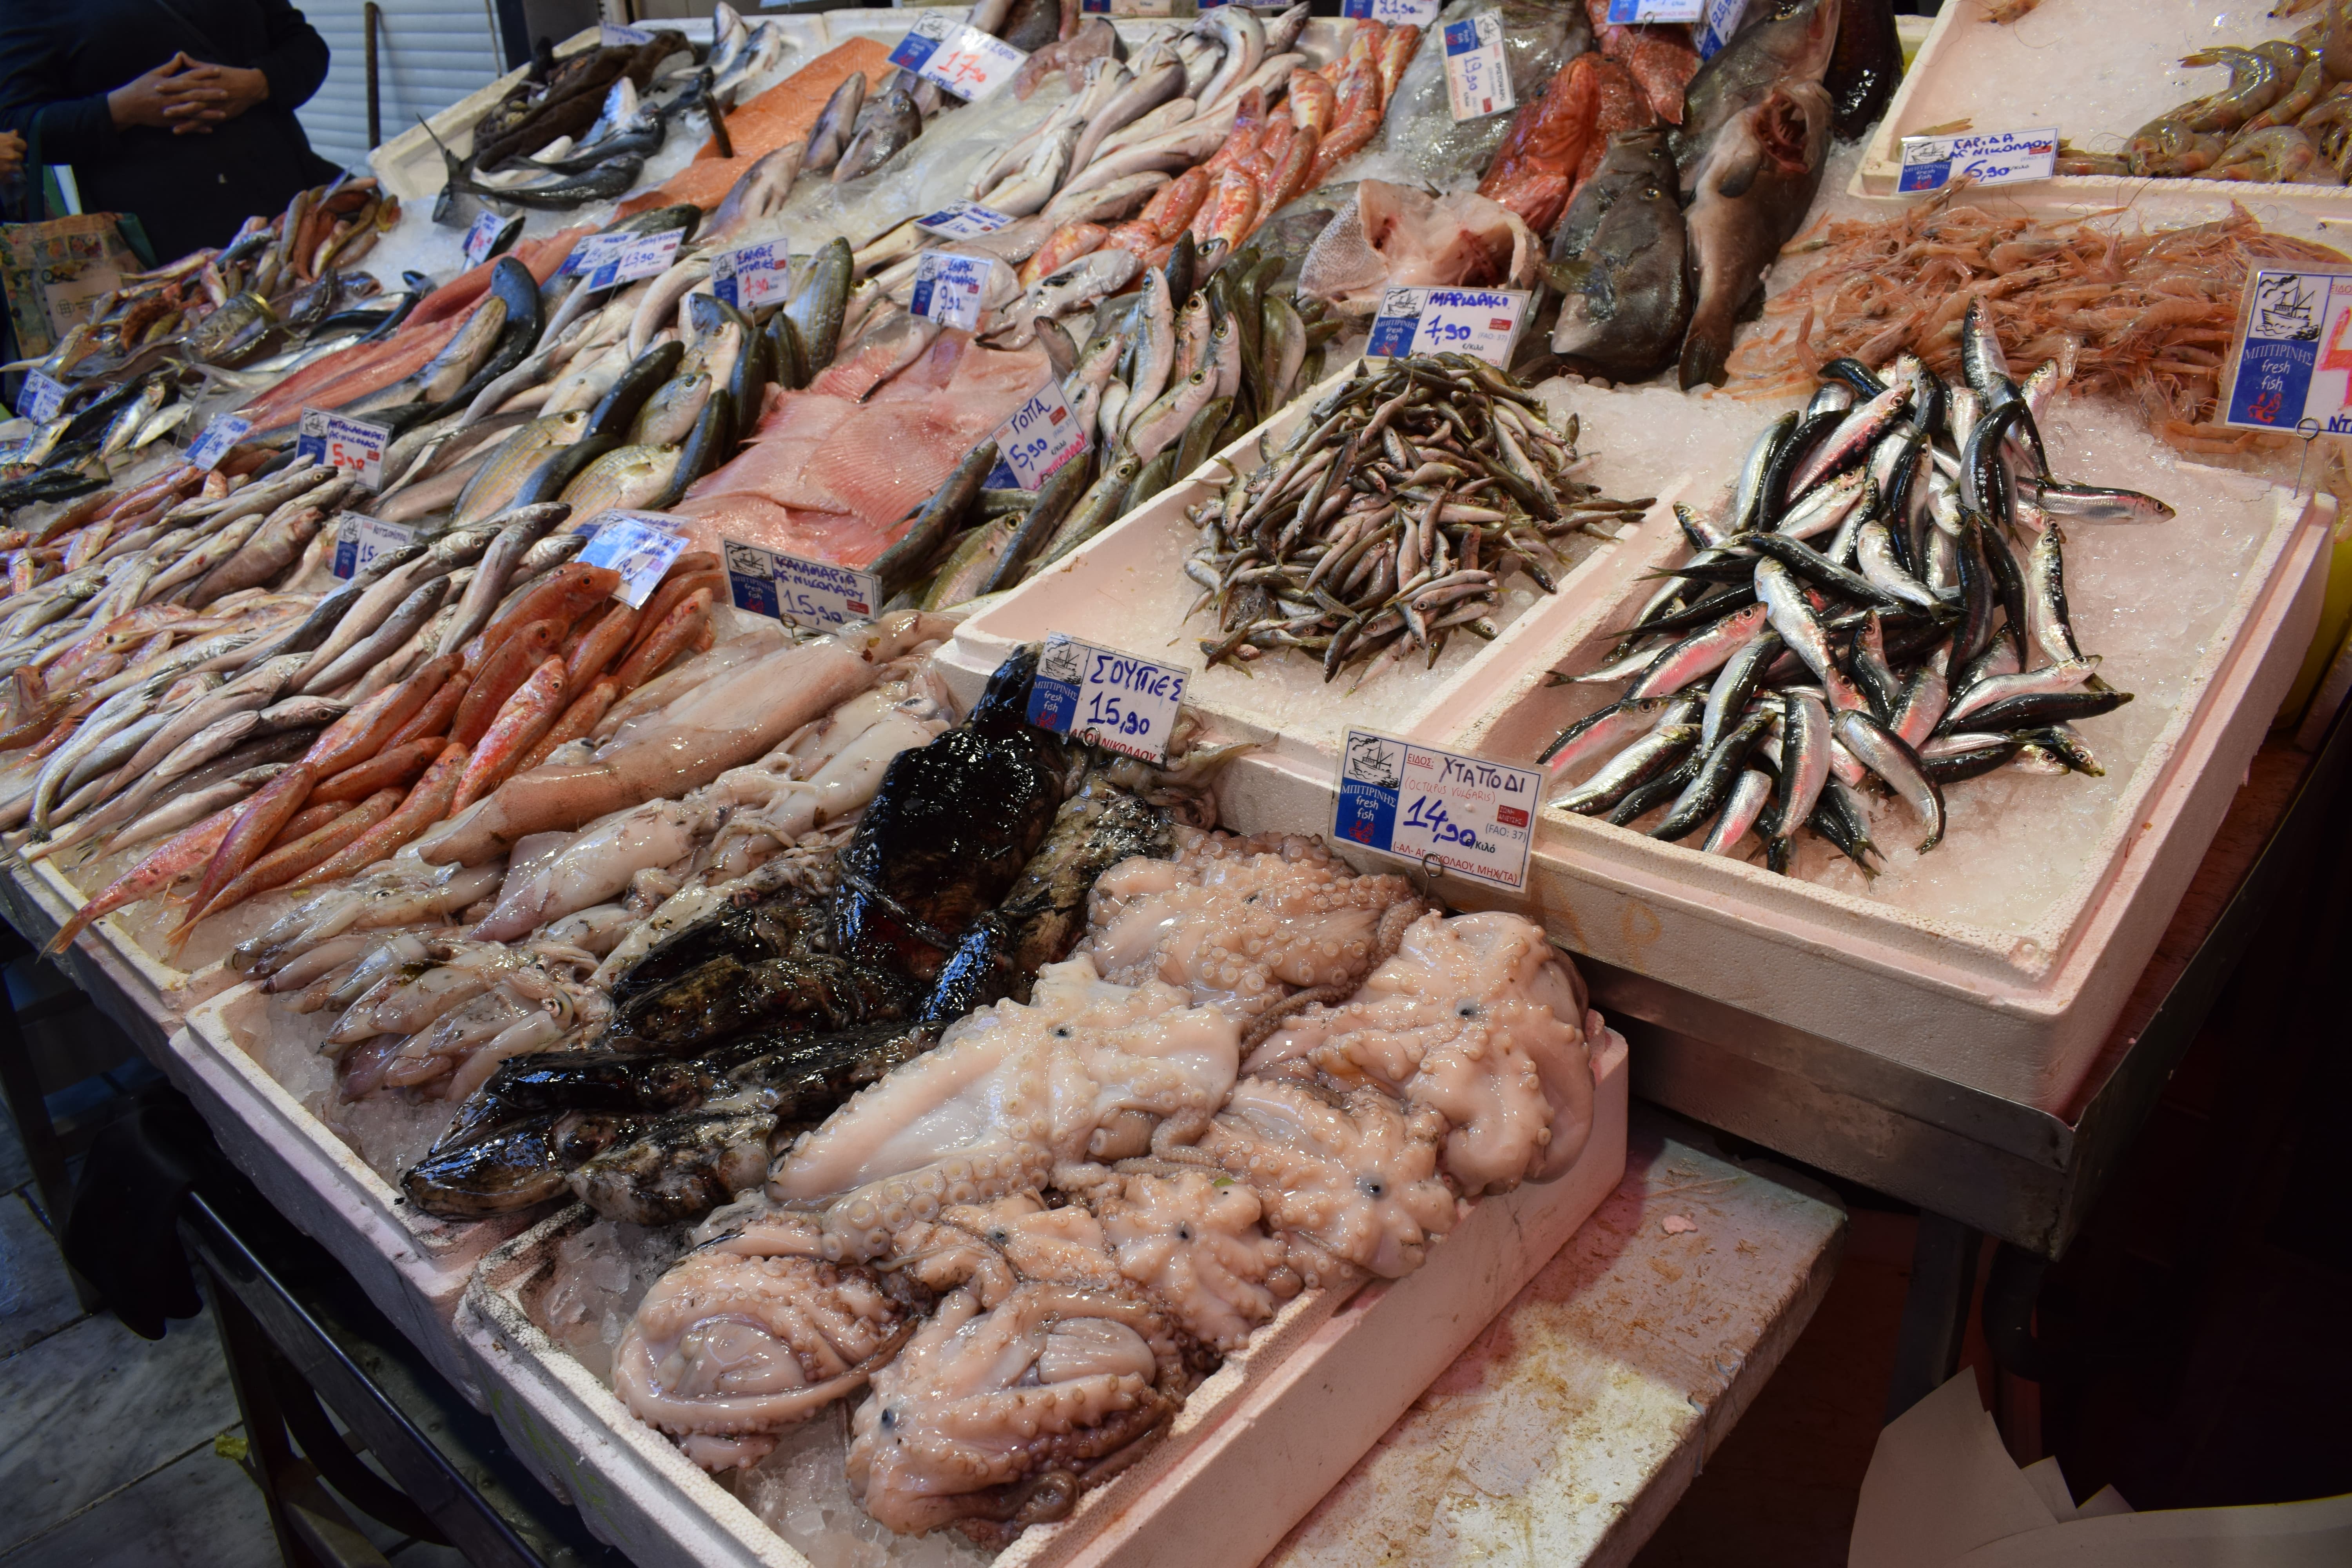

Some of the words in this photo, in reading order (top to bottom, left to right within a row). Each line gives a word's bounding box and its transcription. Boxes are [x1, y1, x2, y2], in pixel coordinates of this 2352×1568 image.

[1462, 56, 1482, 91] 19,90
[1963, 160, 2010, 182] 6,90
[1428, 292, 1509, 309] ΜΑΡΙΔΑΚΙ
[2243, 344, 2314, 367] ΜΠΙΤΙΡΙΝΗΣ
[2262, 359, 2291, 375] fresh
[2261, 376, 2283, 391] fish
[2328, 414, 2352, 434] ΝΤ
[1009, 438, 1047, 472] 5,90
[784, 589, 844, 625] 15,90
[1090, 655, 1184, 702] ΣΟΥΠΙΕΣ
[1033, 681, 1078, 701] ΜΠΙΤΙΡΙΝΗΣ
[1044, 690, 1063, 703] fresh
[1044, 702, 1058, 712] fish
[1087, 691, 1151, 735] 15,90
[1102, 738, 1156, 761] ΝΙΚΟΛΑΟΥ
[1406, 753, 1434, 768] ΕΙΔΟΣ:
[1439, 757, 1525, 793] ΧΤΑΠΟΔΙ
[1341, 784, 1396, 808] ΜΠΙΤΙΡΙΝΗΣ
[1356, 796, 1379, 810] fresh
[1452, 787, 1496, 804] VULGARIS)
[1357, 807, 1374, 821] fish
[1403, 795, 1476, 846] 14,90
[1486, 823, 1509, 837] (FAO:
[1512, 830, 1526, 843] 37)
[1477, 865, 1517, 884] ΜΗΧ/ΤΑ)
